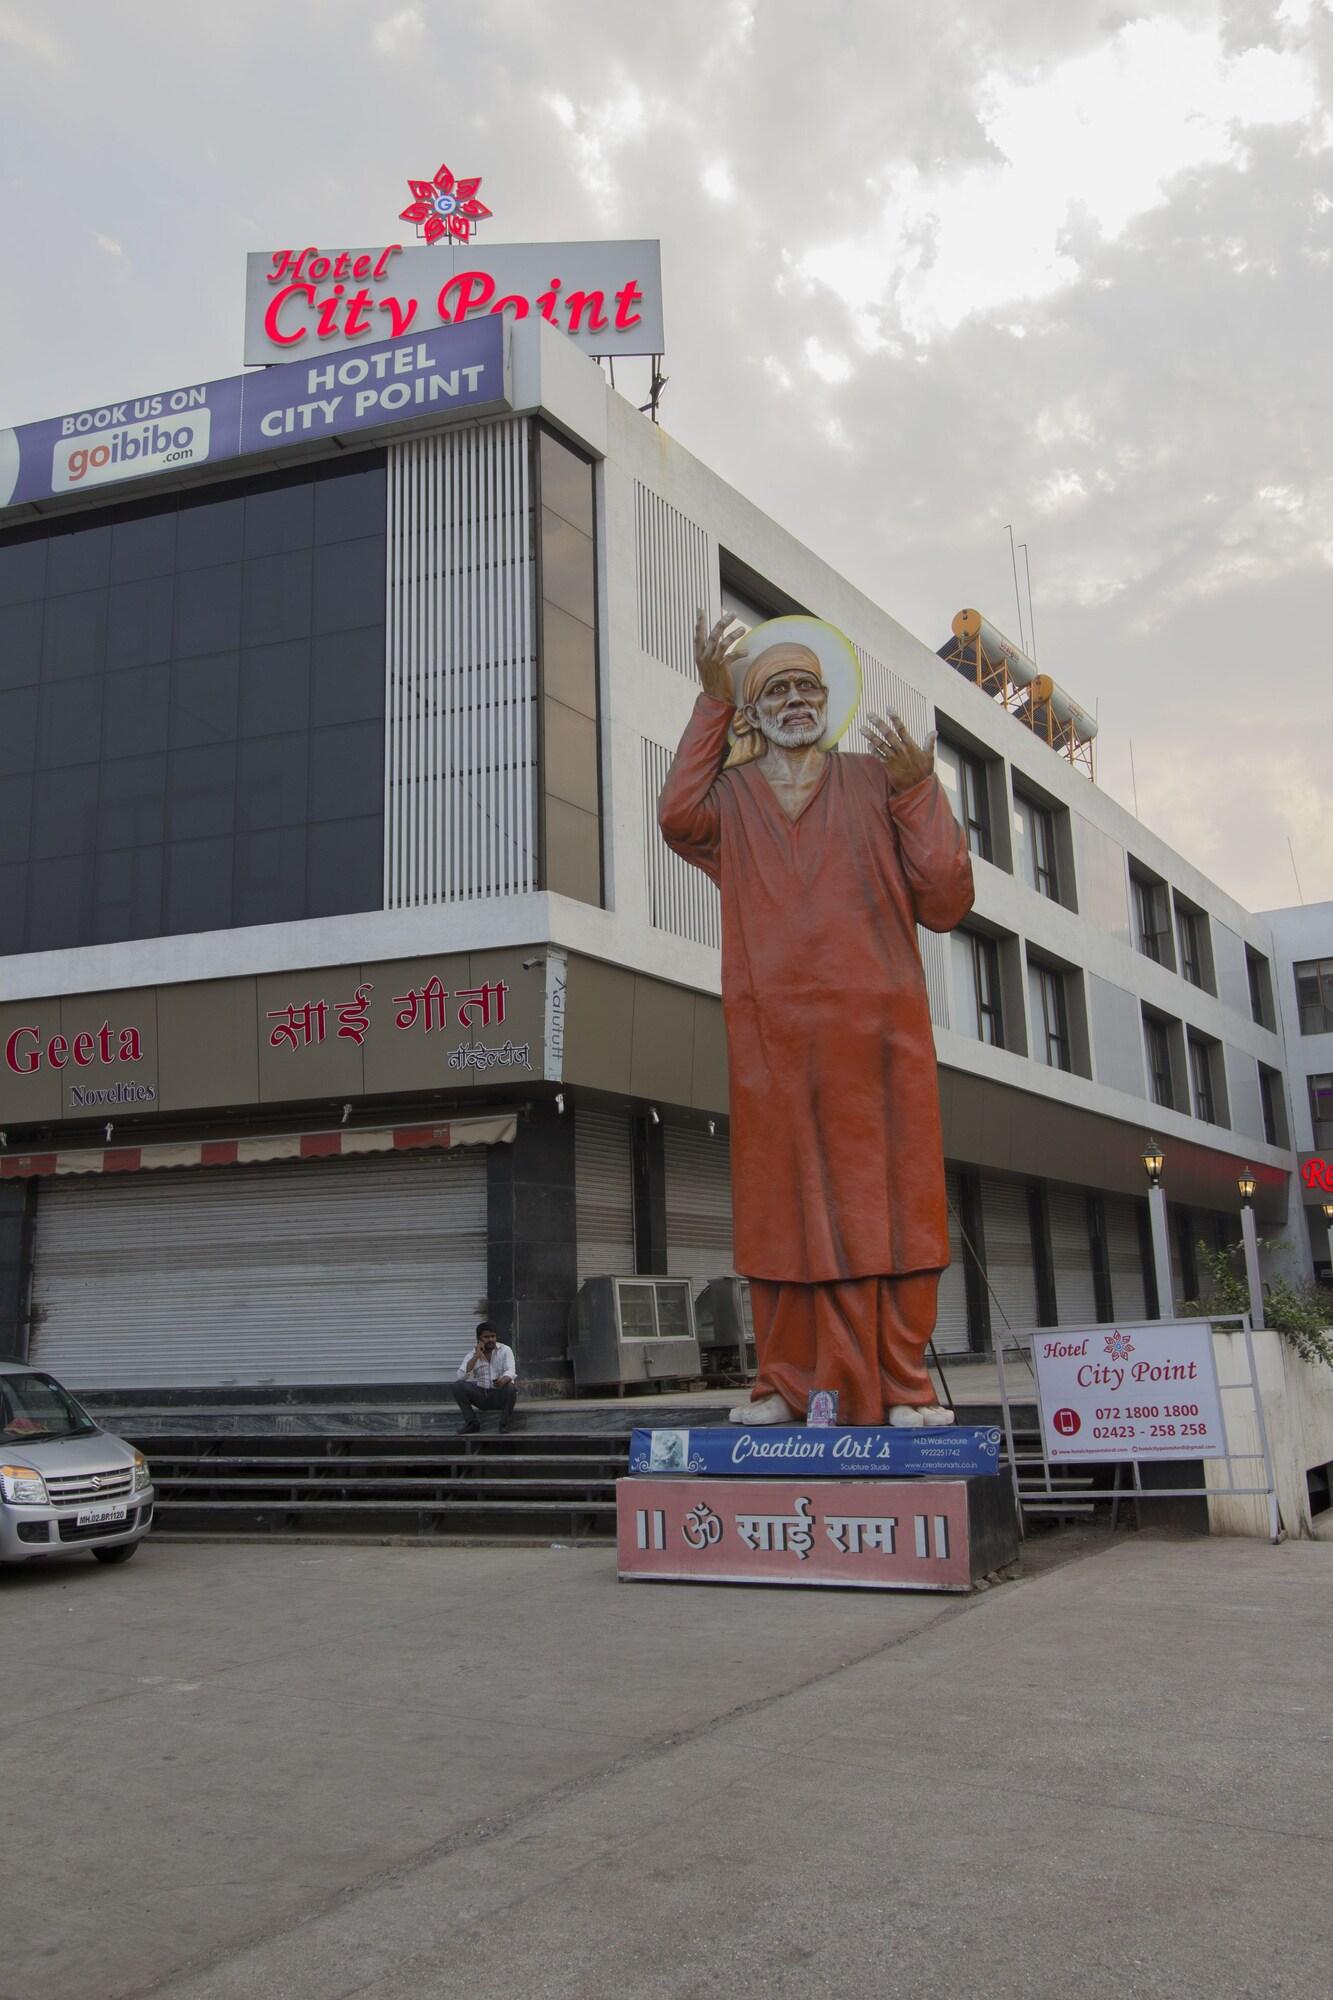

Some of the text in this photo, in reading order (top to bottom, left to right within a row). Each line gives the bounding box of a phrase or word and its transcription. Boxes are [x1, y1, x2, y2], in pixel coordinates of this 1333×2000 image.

[266, 244, 403, 283] Hotel
[264, 271, 643, 346] City Point
[307, 343, 436, 394] HOTEL
[62, 386, 207, 436] BOOK US ON
[260, 364, 485, 437] CITY POINT
[68, 423, 194, 481] goibibo
[266, 975, 509, 1052] साई गीता
[5, 1019, 143, 1075] Geeta
[69, 1080, 156, 1108] Novelties
[1044, 1338, 1090, 1359] Hotel
[1077, 1359, 1197, 1391] City Point
[1093, 1426, 1135, 1439] 02423
[1150, 1424, 1176, 1437] 258
[1180, 1423, 1207, 1436] 258
[1095, 1404, 1199, 1420] 072 1800 1800
[732, 1434, 891, 1463] Creation Art's
[840, 1463, 890, 1472] Sculpture Studio
[735, 1496, 816, 1560] साई
[824, 1515, 898, 1554] राम
